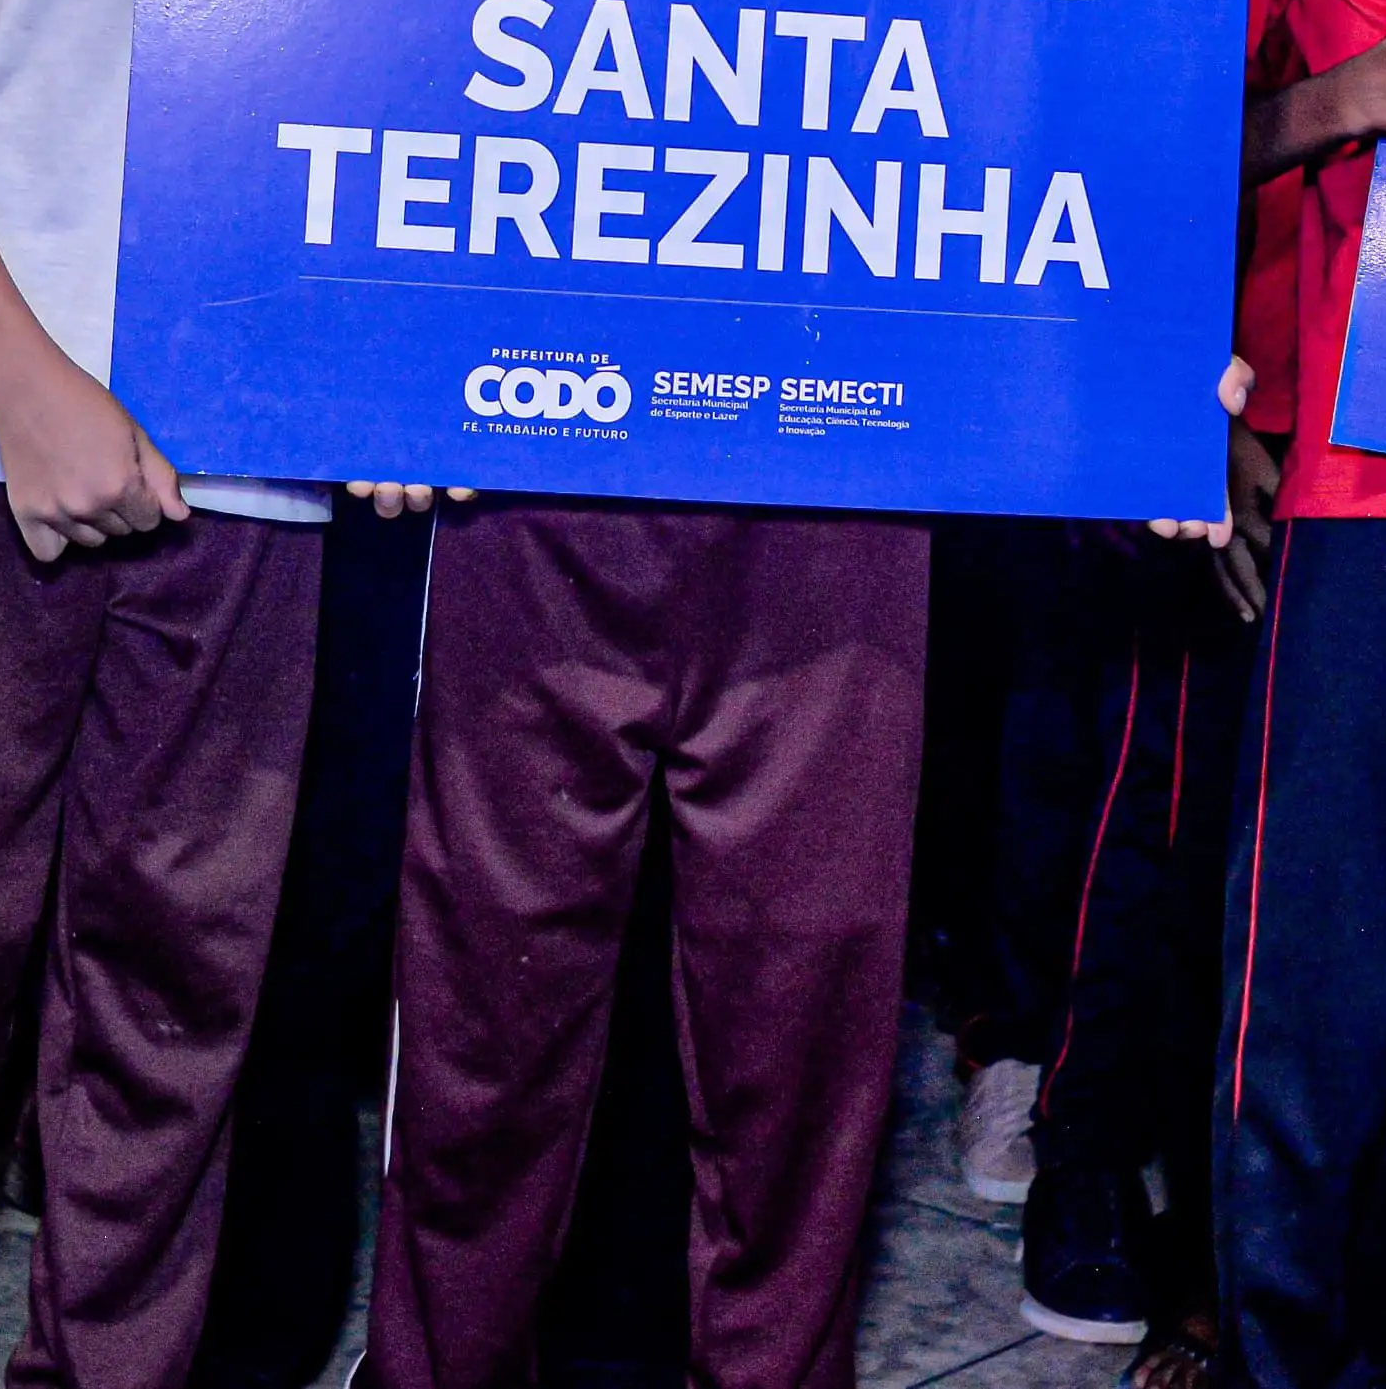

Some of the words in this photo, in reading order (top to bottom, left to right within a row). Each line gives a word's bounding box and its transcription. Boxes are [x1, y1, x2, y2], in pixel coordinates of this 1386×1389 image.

[277, 123, 1110, 290] TEREZINHA
[491, 348, 584, 363] PREFEITURA
[591, 354, 609, 364] DE
[464, 365, 632, 423] CODÓ
[653, 371, 770, 399] SEMESP
[780, 378, 903, 406] SEMECTI
[702, 399, 749, 411] Municipal
[826, 406, 868, 416] Municipal
[487, 423, 558, 437] TRABALHO
[562, 427, 570, 437] E
[575, 427, 628, 440] FUTURO
